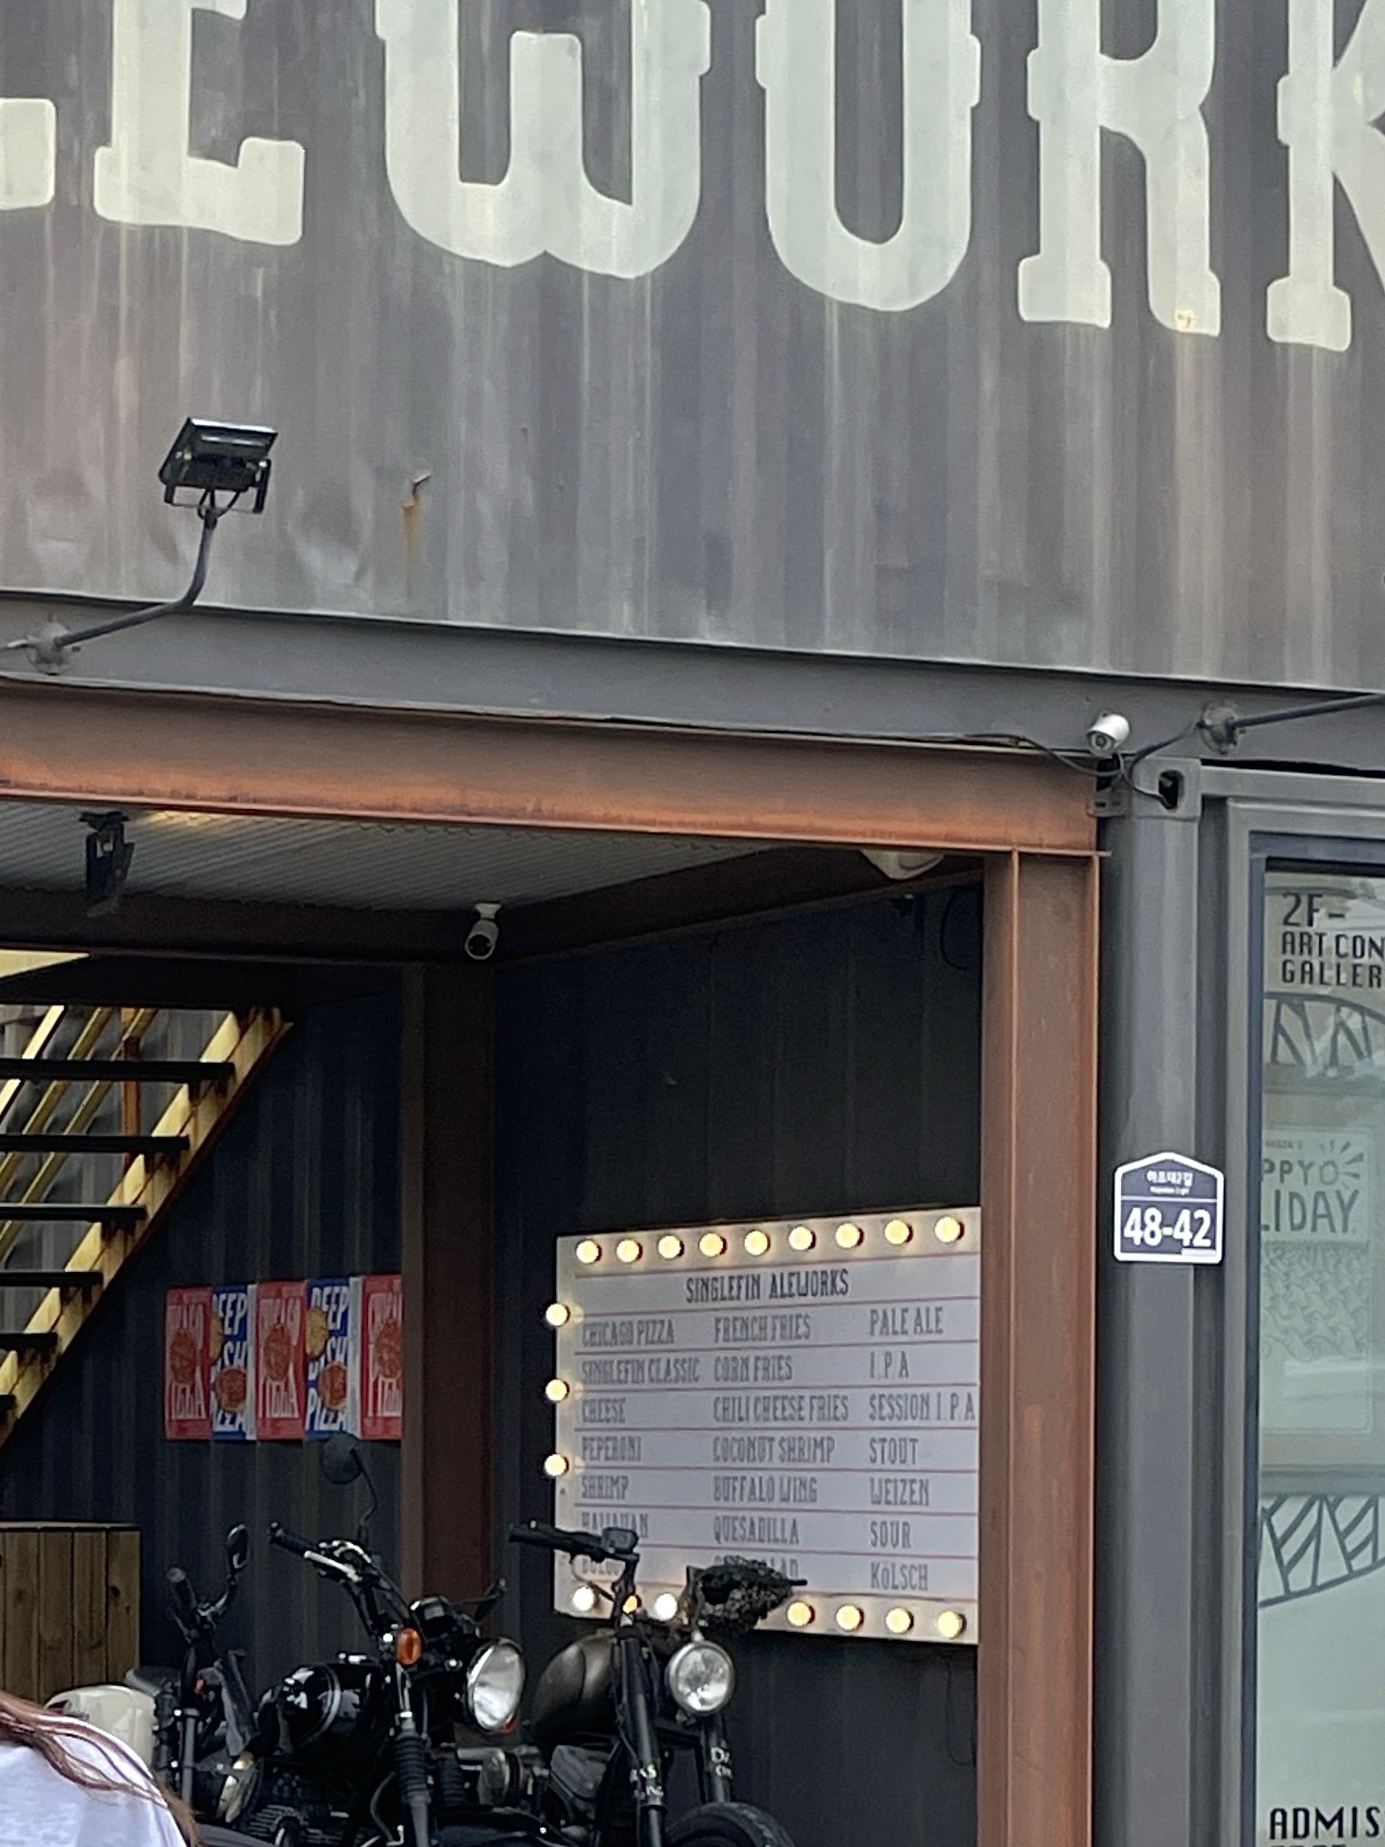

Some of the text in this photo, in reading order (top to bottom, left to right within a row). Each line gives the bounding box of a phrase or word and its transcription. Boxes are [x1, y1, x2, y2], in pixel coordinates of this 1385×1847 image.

[1281, 931, 1327, 957] ART
[1262, 1189, 1360, 1234] IDAY
[1123, 1207, 1212, 1248] 48-42
[686, 1268, 850, 1304] SINGLEFIN ALEWORKS
[582, 1319, 675, 1348] CHICAGO PIZZA
[714, 1313, 811, 1344] FRENCH FRIES
[869, 1306, 944, 1337] PALE ALE
[582, 1357, 700, 1385] SINGLEFIN CLASSIC
[714, 1354, 793, 1383] CORN FRIES
[582, 1398, 627, 1424] CHEESE
[714, 1394, 850, 1423] CHILI CHEESE FRIES
[868, 1393, 930, 1422] SESSION
[713, 1436, 835, 1464] COCONUT SHRIMP
[869, 1437, 919, 1465] STOUT
[581, 1475, 629, 1500] SHRIMP
[713, 1475, 818, 1503] BUFFALO WING
[869, 1477, 930, 1506] WEIZEN
[714, 1515, 800, 1545] QUESADILLA
[870, 1520, 912, 1549] SOUR
